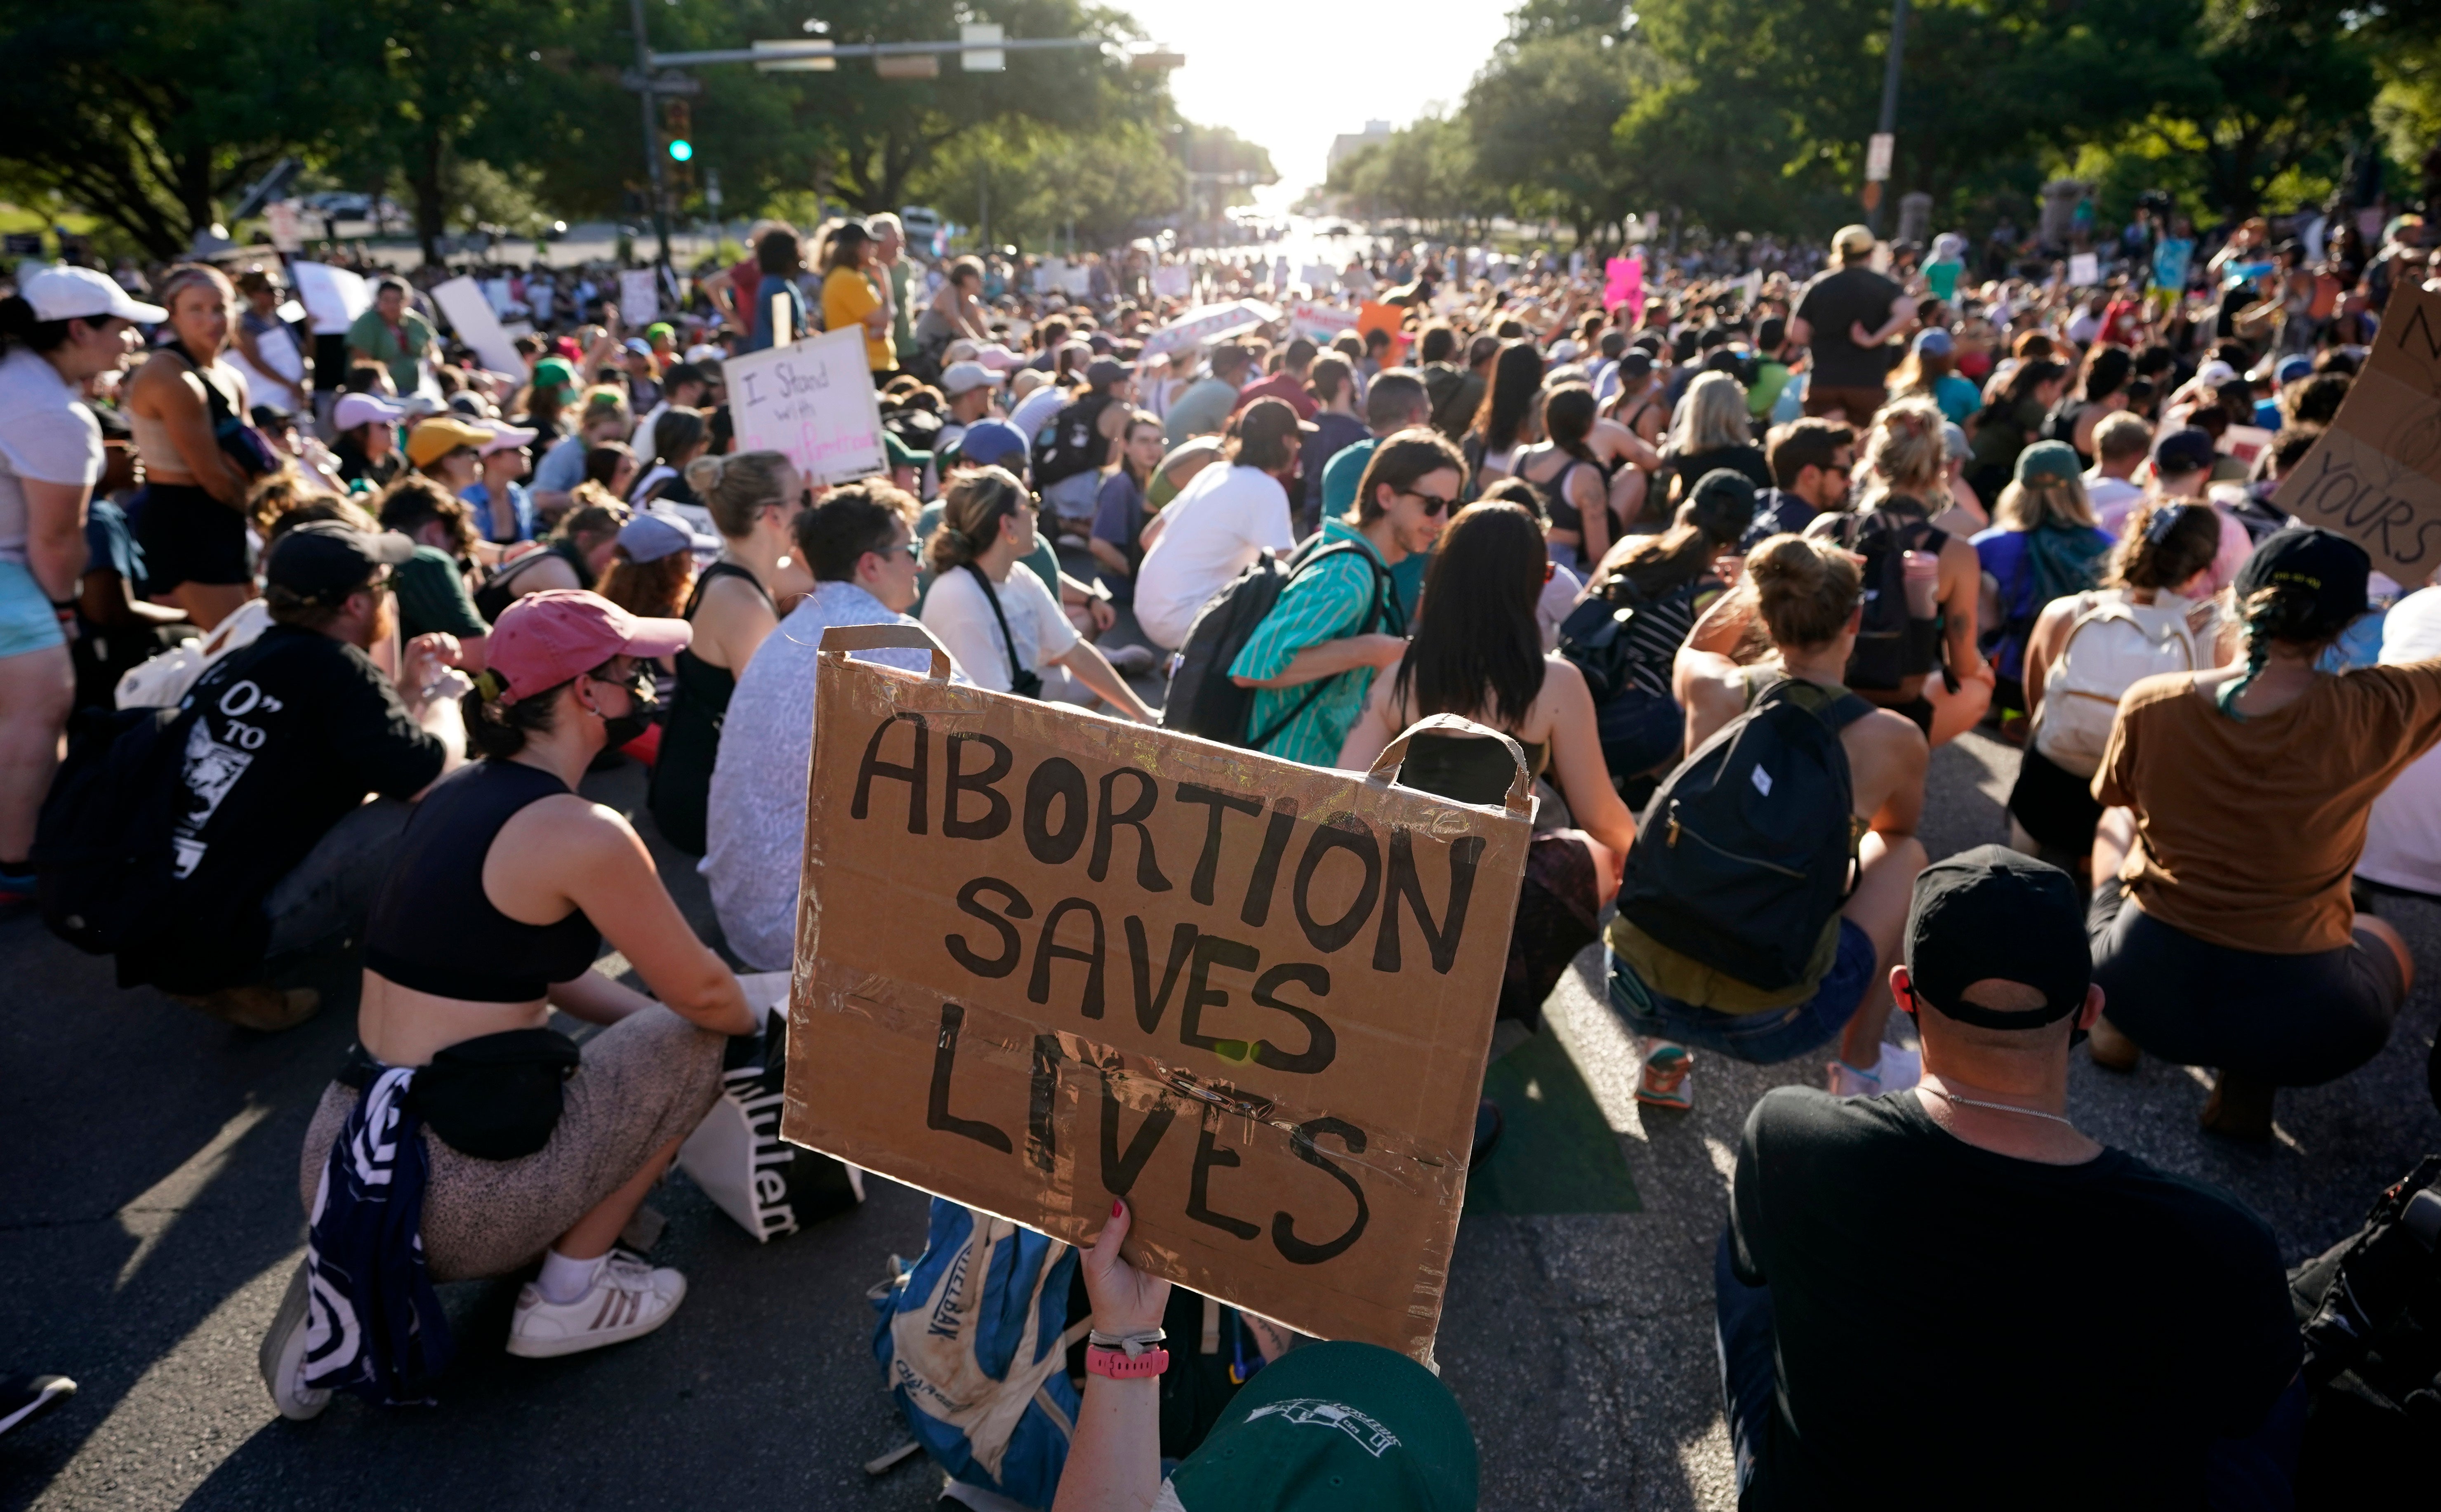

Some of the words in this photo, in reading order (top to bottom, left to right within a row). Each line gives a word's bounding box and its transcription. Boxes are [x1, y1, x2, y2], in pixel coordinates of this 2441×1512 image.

[741, 372, 766, 407] I
[775, 360, 830, 398] Stand
[2297, 451, 2441, 563] YOURS
[223, 719, 267, 749] TO
[851, 712, 1487, 973] ABORTION
[945, 876, 1336, 1073] SAVES
[926, 1004, 1369, 1264] LIVES
